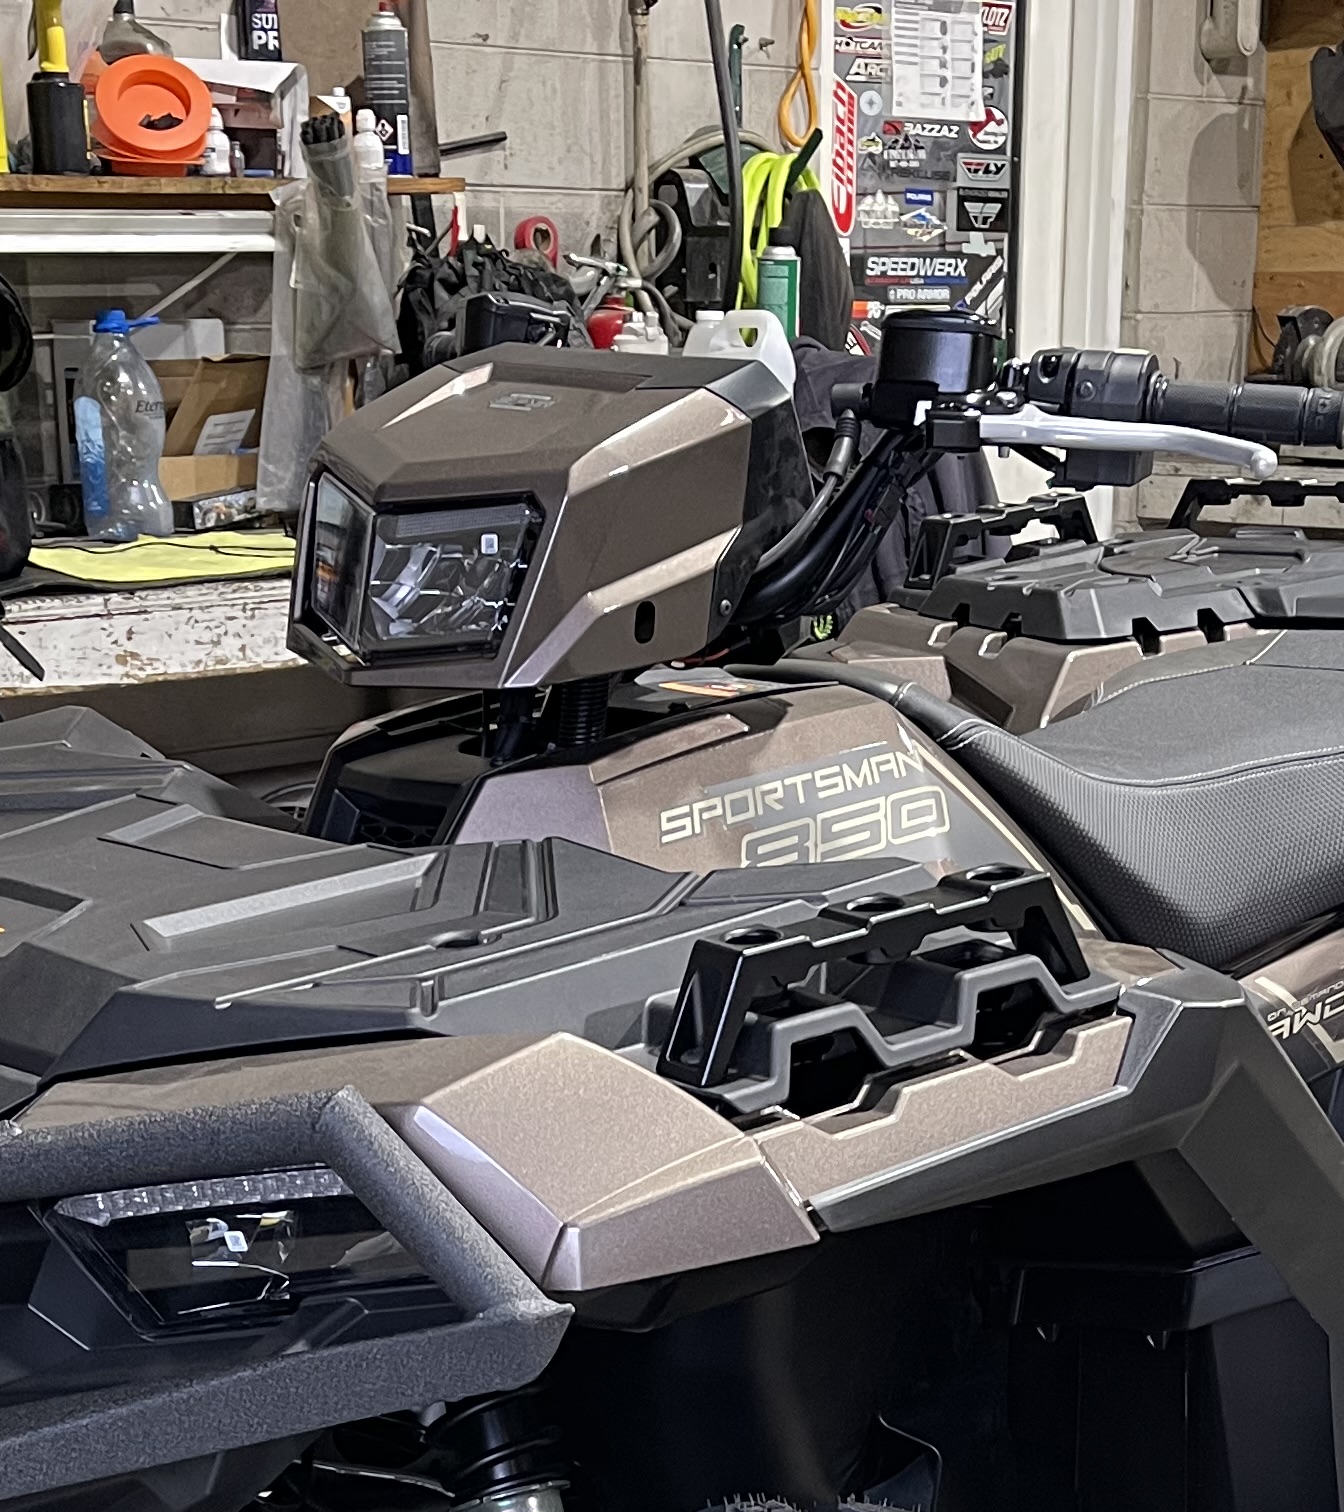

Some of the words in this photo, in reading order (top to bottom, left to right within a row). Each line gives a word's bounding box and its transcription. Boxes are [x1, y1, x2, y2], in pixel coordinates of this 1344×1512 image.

[980, 6, 1010, 26] LOTZ
[866, 256, 968, 277] SPEEDWERX
[896, 288, 917, 300] PRO
[917, 289, 950, 301] ARMOR
[660, 750, 925, 843] SPORTSMAN
